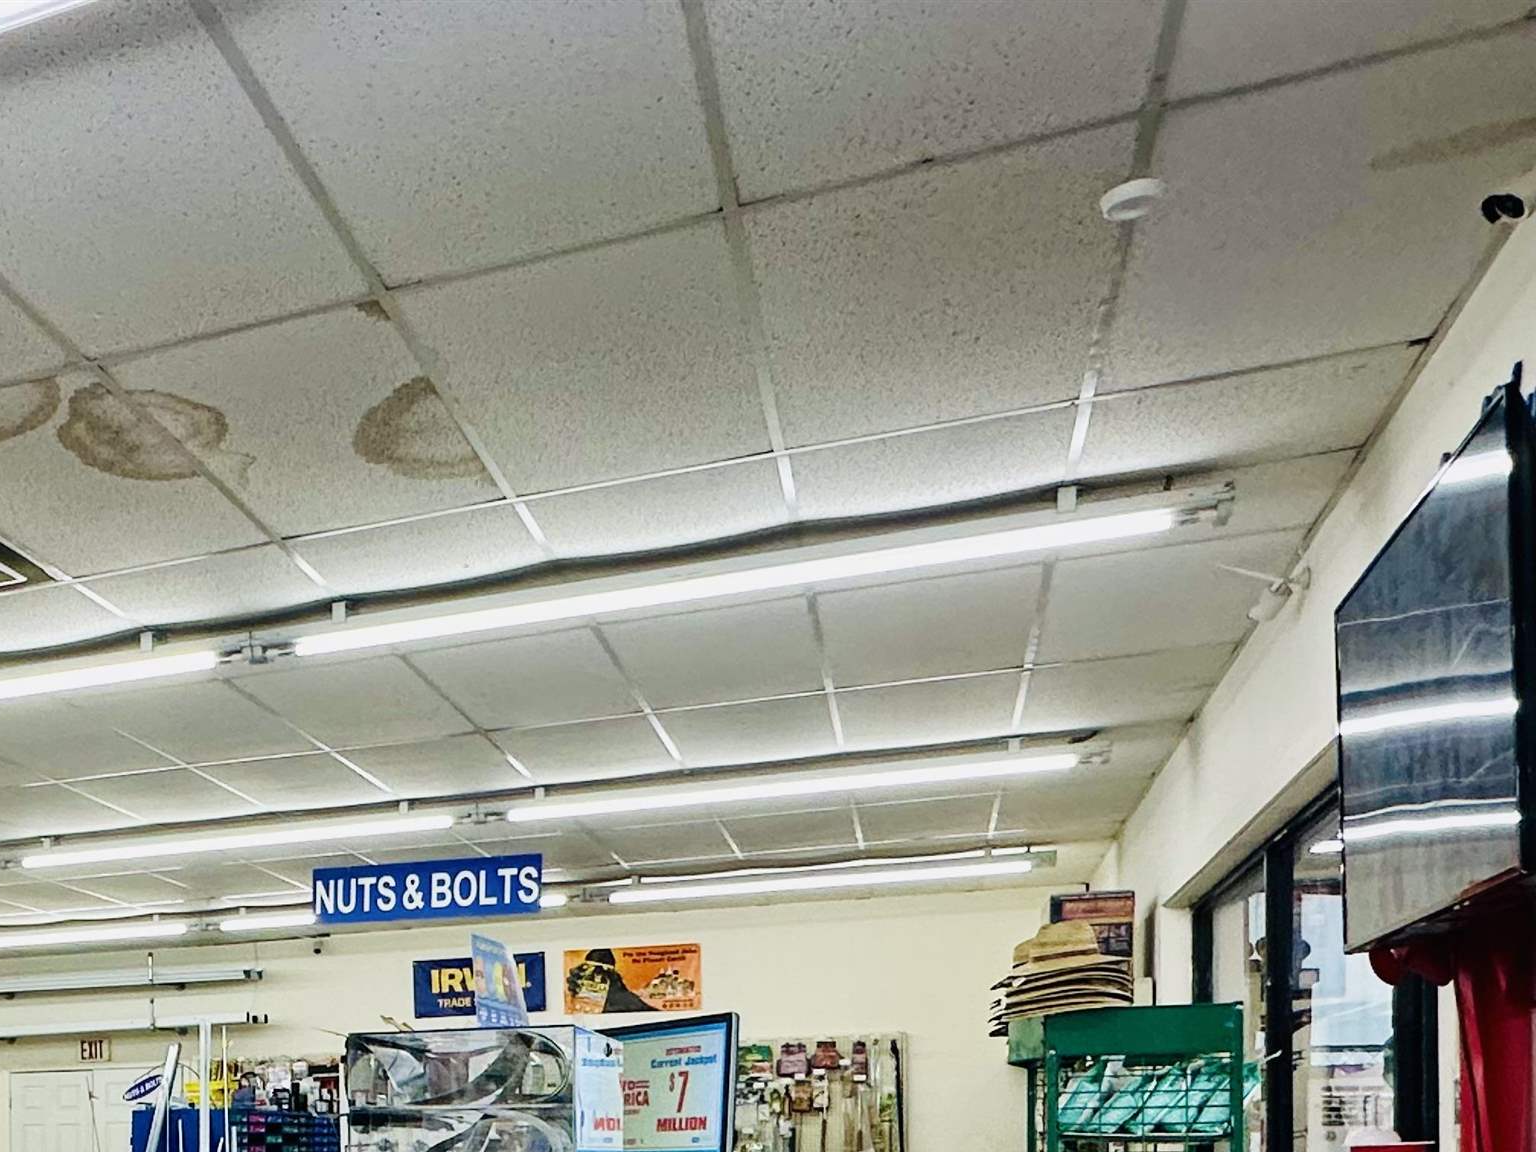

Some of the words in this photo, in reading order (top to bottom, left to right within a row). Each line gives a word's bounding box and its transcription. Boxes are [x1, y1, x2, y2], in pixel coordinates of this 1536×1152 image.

[315, 875, 396, 915] NUTS
[402, 873, 424, 910] &
[430, 866, 539, 908] BOLTS
[438, 997, 471, 1009] TRADE
[80, 1040, 103, 1060] EXIT
[650, 1058, 681, 1069] Current
[685, 1054, 717, 1066] Jackpot
[656, 1117, 707, 1132] MILLION
